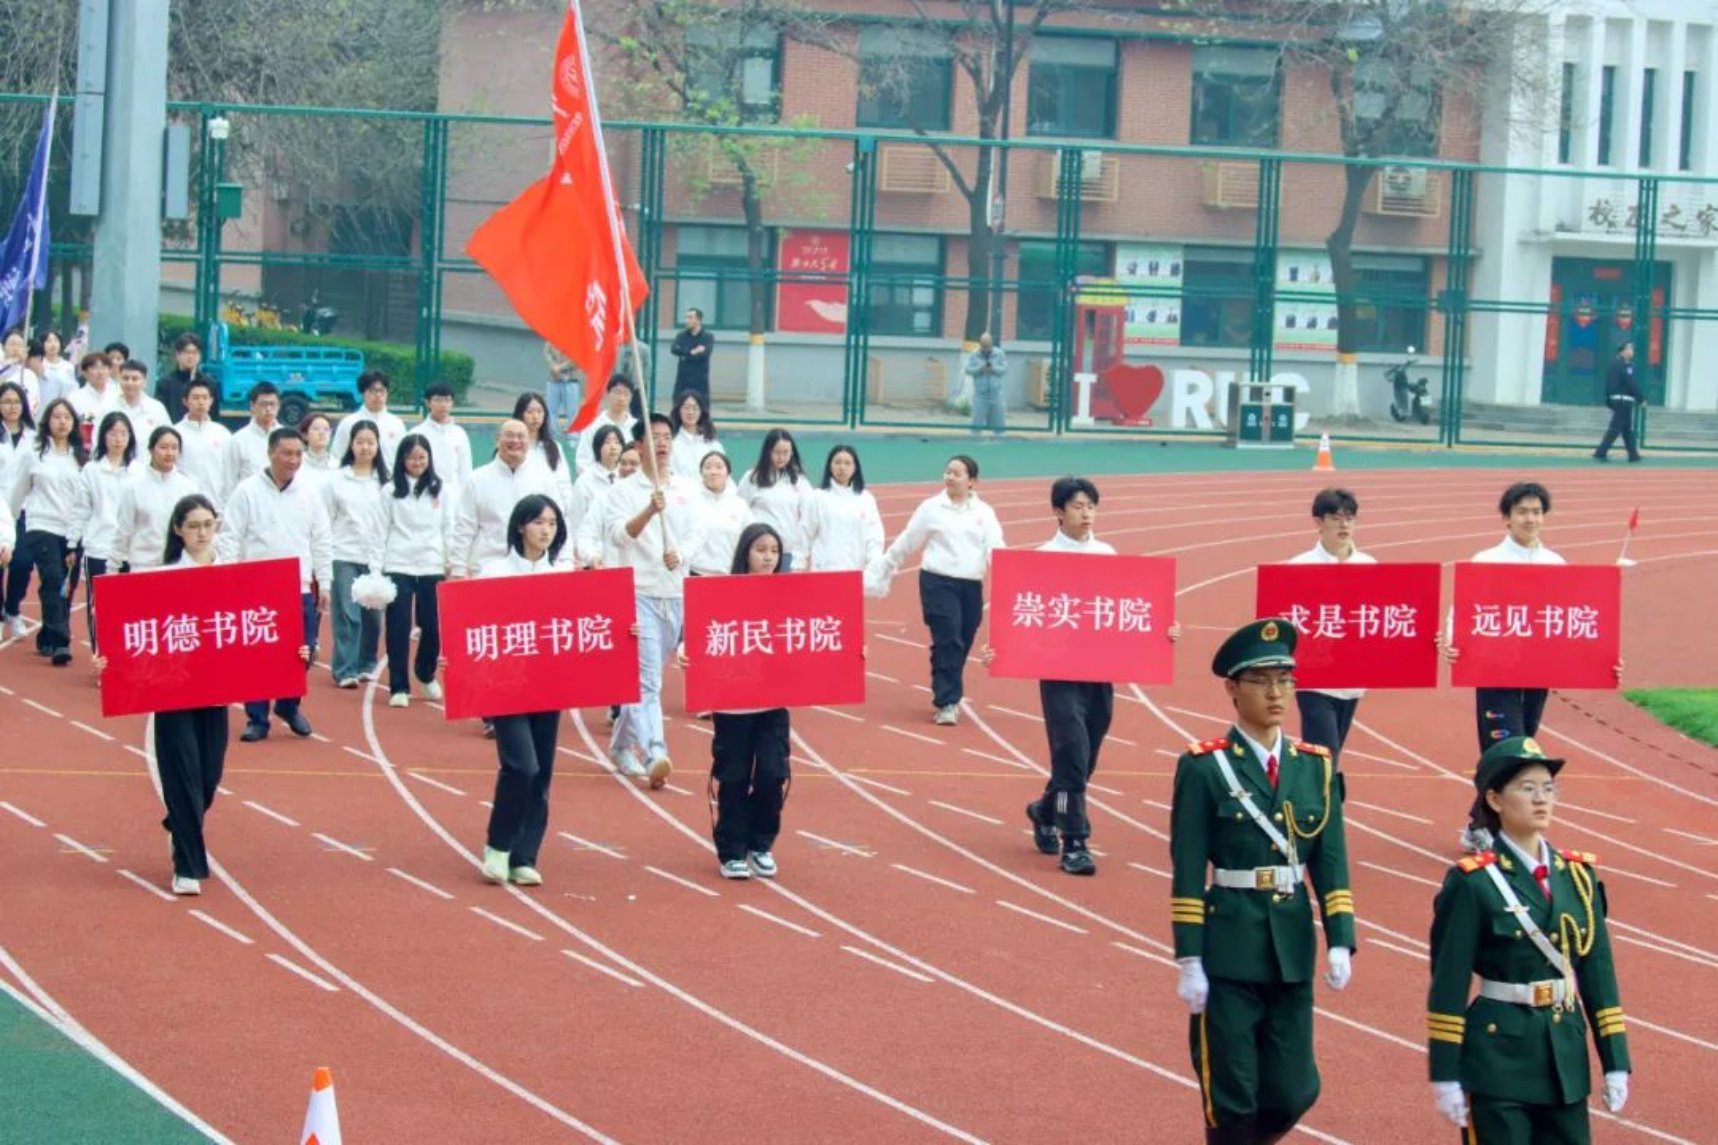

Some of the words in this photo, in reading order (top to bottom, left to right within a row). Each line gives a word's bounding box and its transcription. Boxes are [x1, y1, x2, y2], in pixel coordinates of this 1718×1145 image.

[1071, 373, 1097, 426] I
[123, 607, 279, 656] 明德书院
[1012, 591, 1152, 633] 崇实书院
[1278, 603, 1417, 639] 求是书院
[1471, 604, 1599, 639] 远见书院
[465, 614, 613, 661] 明理书院
[705, 616, 842, 657] 新民书院
